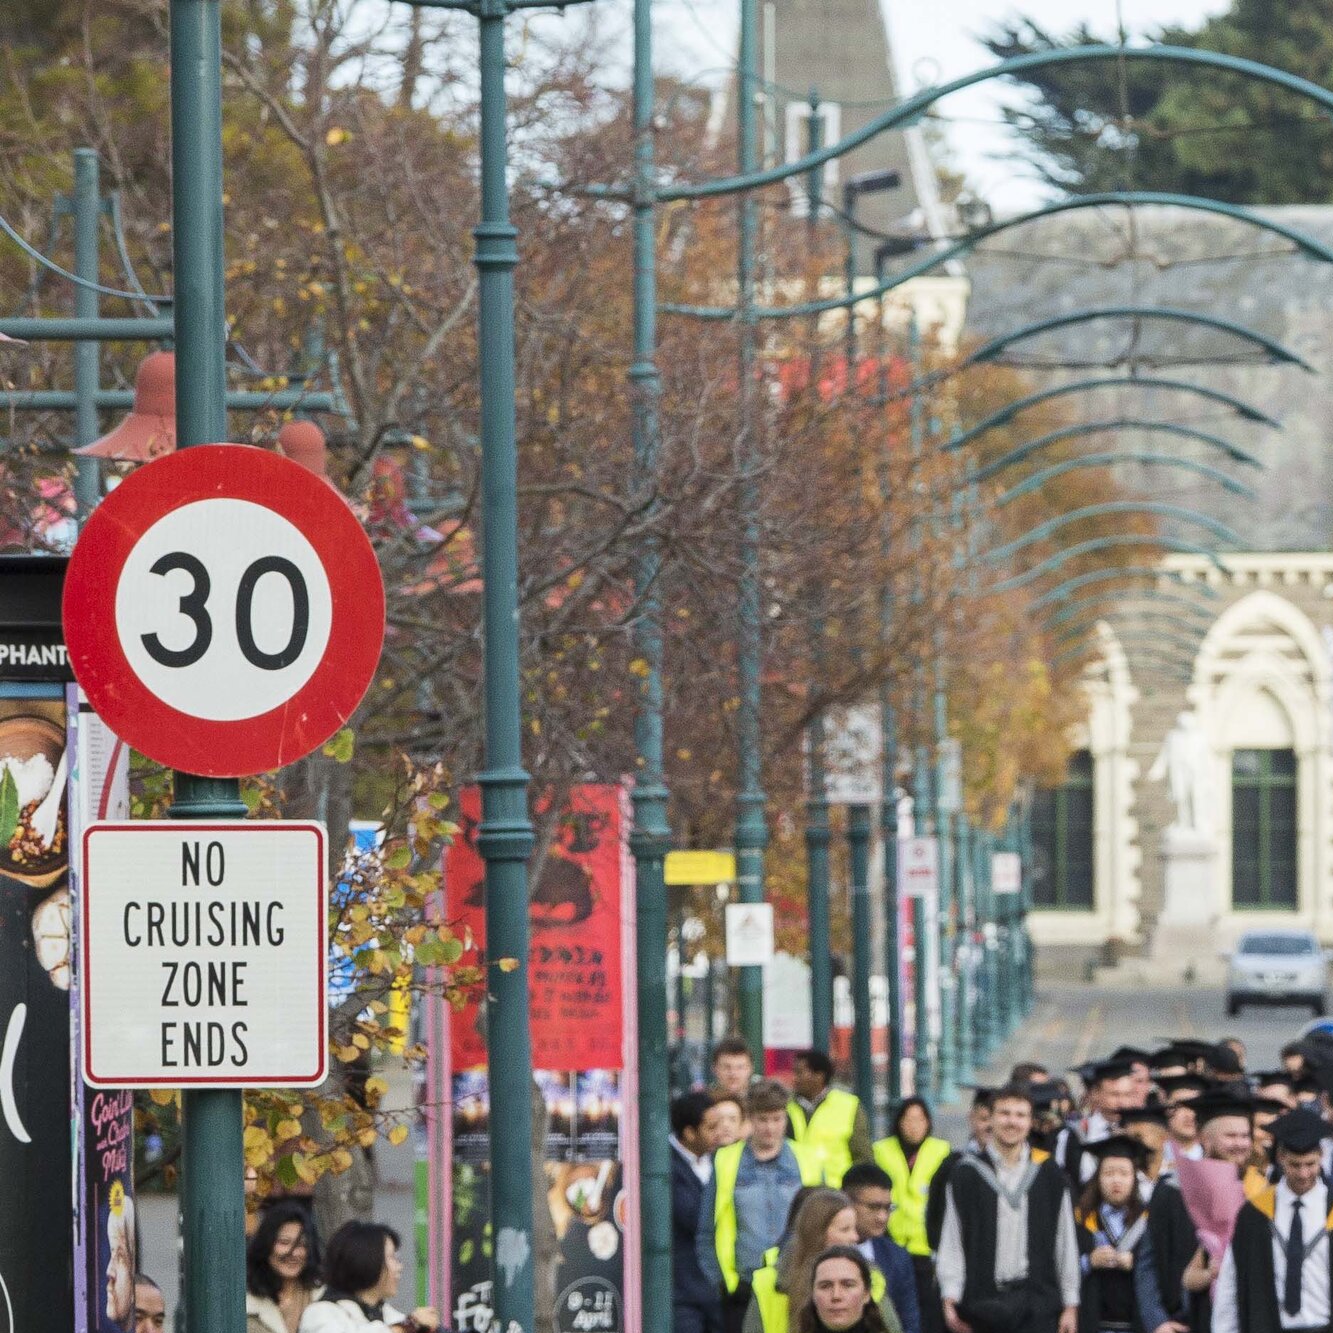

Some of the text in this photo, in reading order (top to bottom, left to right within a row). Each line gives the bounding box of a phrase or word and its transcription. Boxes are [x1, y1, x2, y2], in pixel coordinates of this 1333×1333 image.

[140, 551, 310, 670] 30
[181, 841, 225, 886] NO
[123, 901, 285, 947] CRUISING
[161, 962, 248, 1007] ZONE
[161, 1021, 248, 1067] ENDS
